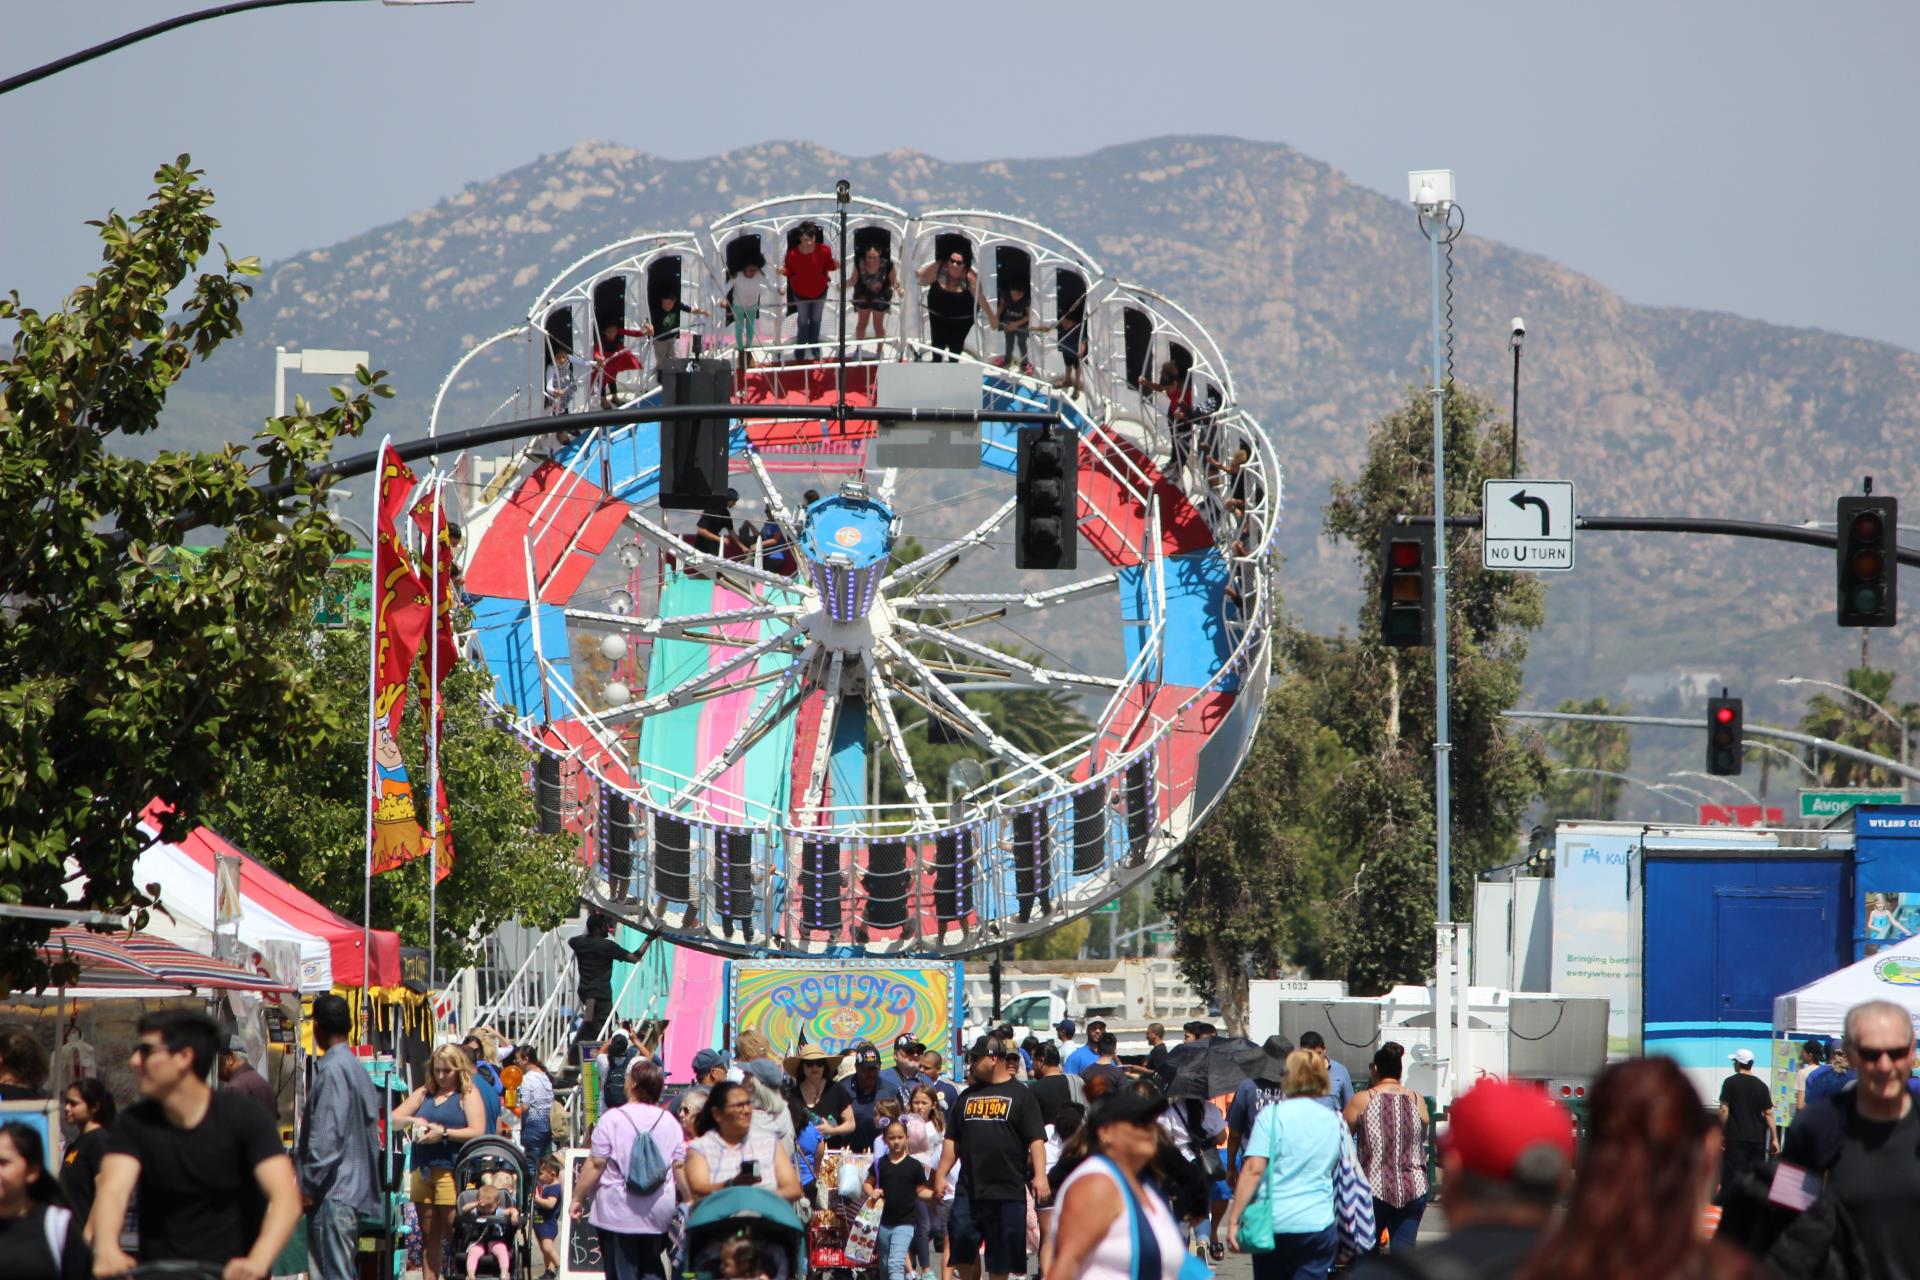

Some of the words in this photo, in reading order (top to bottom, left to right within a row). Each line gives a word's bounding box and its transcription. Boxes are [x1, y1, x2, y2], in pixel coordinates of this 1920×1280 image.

[1491, 548, 1509, 559] NO
[1514, 546, 1527, 561] U
[1531, 548, 1565, 560] TURN
[1869, 819, 1906, 828] WYLAND
[1567, 954, 1607, 964] Bringing
[1566, 970, 1621, 978] everywhere
[770, 974, 916, 1020] ROUND
